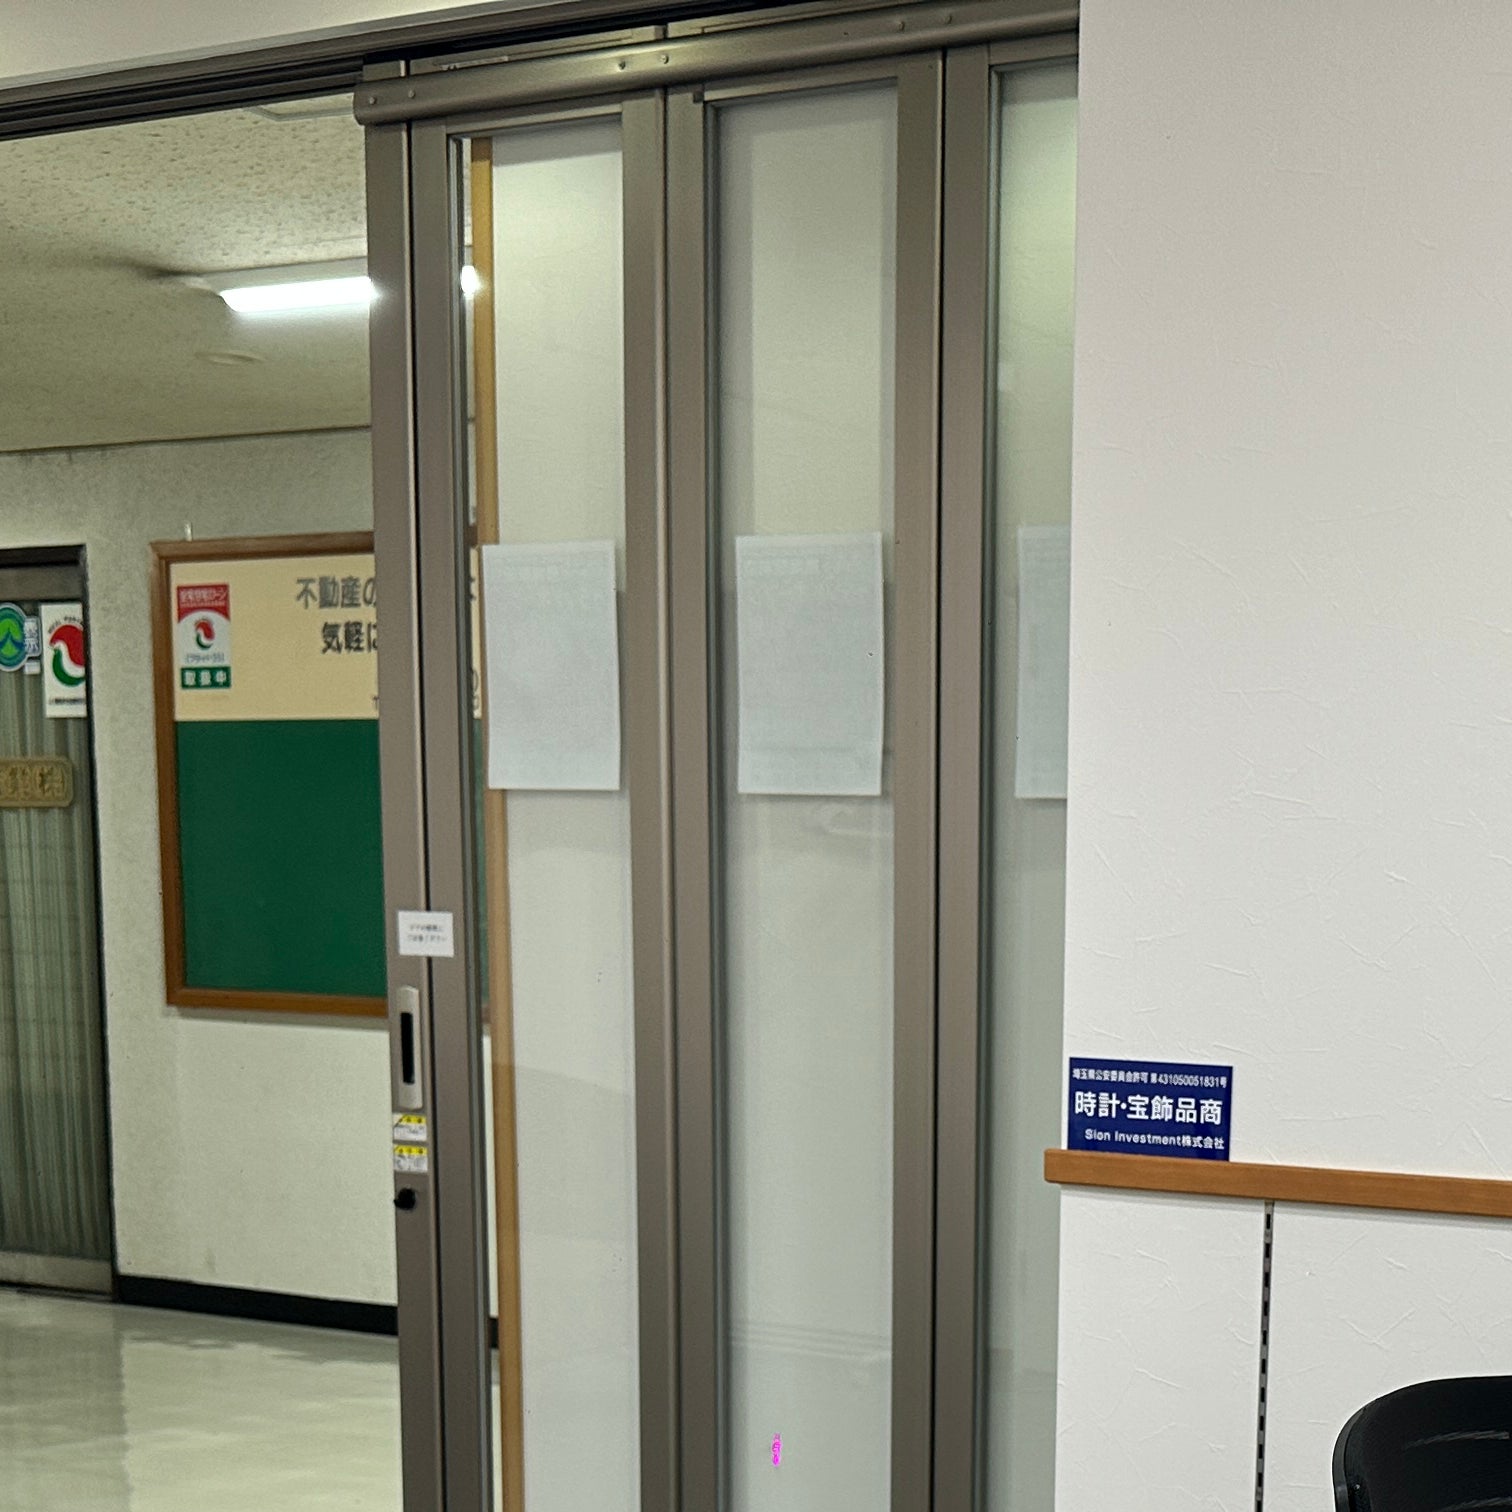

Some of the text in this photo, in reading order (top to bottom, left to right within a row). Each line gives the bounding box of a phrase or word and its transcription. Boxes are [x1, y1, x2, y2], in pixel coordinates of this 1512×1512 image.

[1074, 1091, 1223, 1125] 時計・宝飾品商
[1085, 1129, 1111, 1141] Sion
